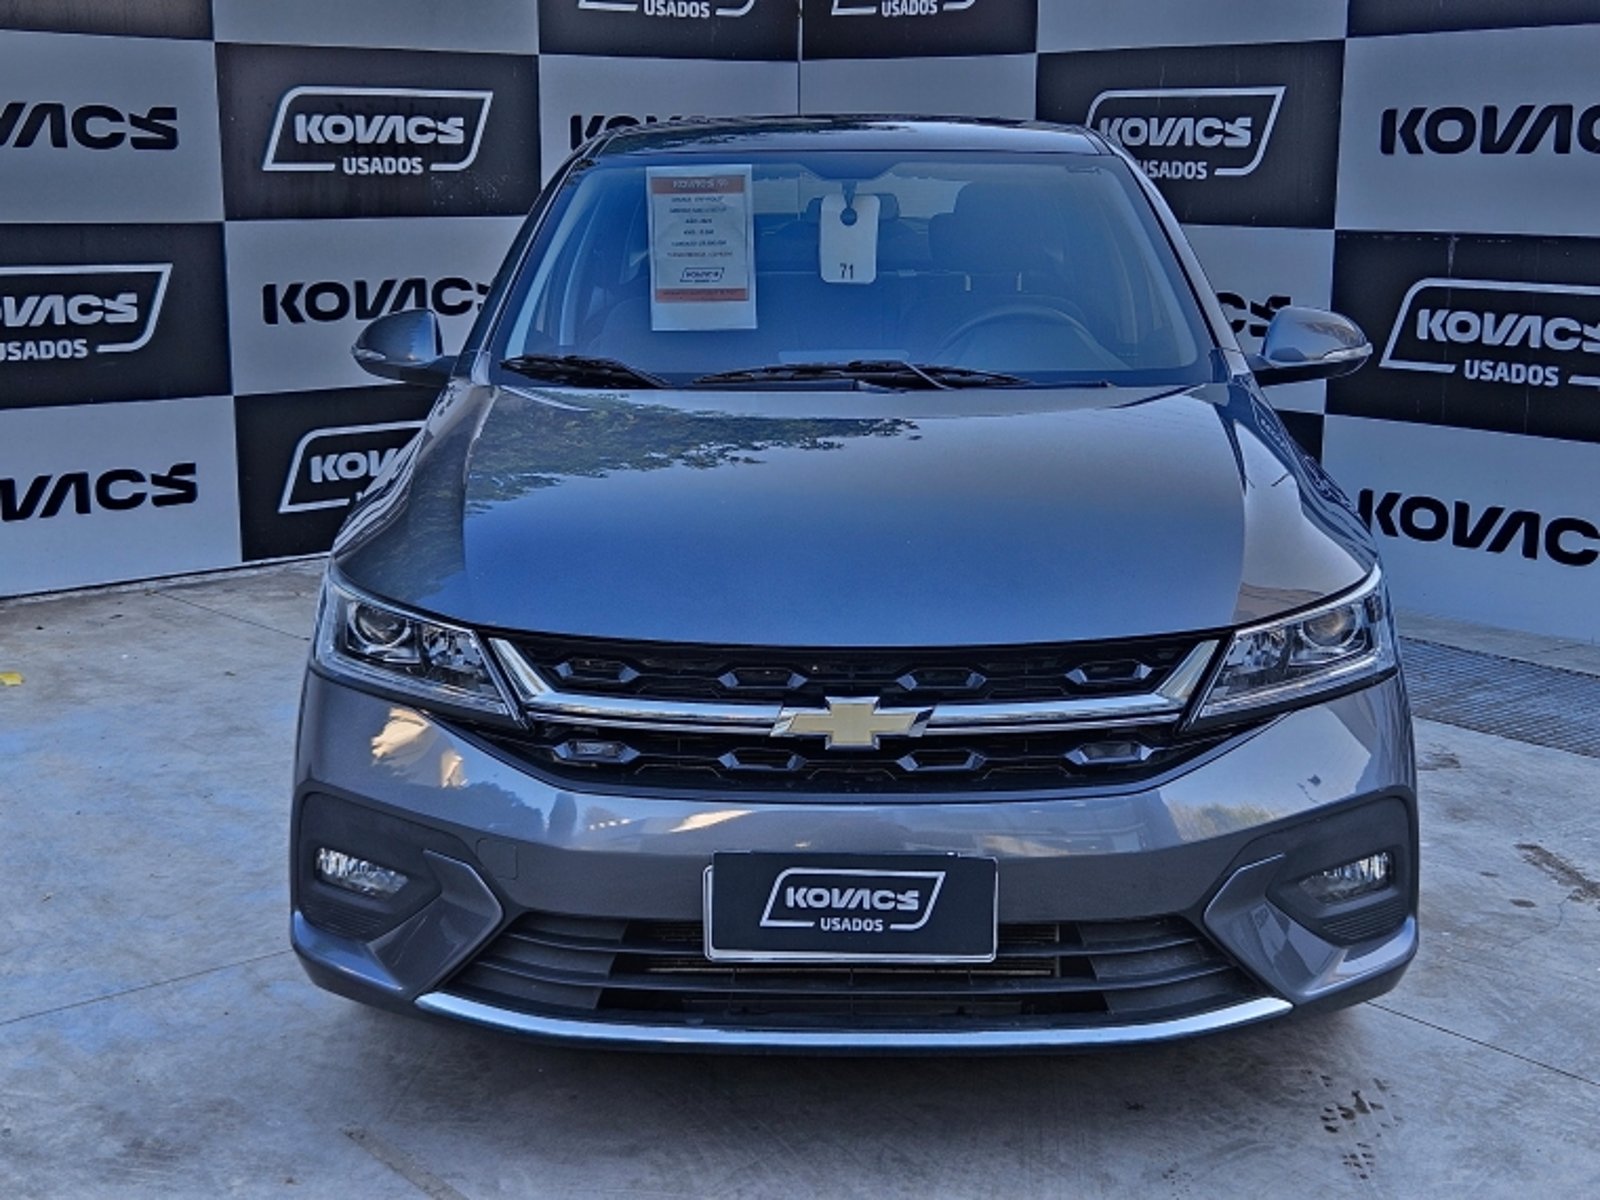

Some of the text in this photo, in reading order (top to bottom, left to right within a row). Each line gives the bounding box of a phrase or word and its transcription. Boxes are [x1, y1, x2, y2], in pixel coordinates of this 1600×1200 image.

[643, 0, 710, 18] USADOS
[881, 0, 938, 17] USADOS
[295, 114, 464, 144] KOVACS
[1100, 117, 1251, 147] KOVACS
[342, 157, 424, 175] USADOS
[839, 263, 854, 279] 71
[0, 293, 138, 327] VACS
[1464, 359, 1559, 387] USADOS
[311, 447, 400, 483] KOV
[785, 886, 919, 911] KOVACS
[820, 917, 884, 932] USADOS
